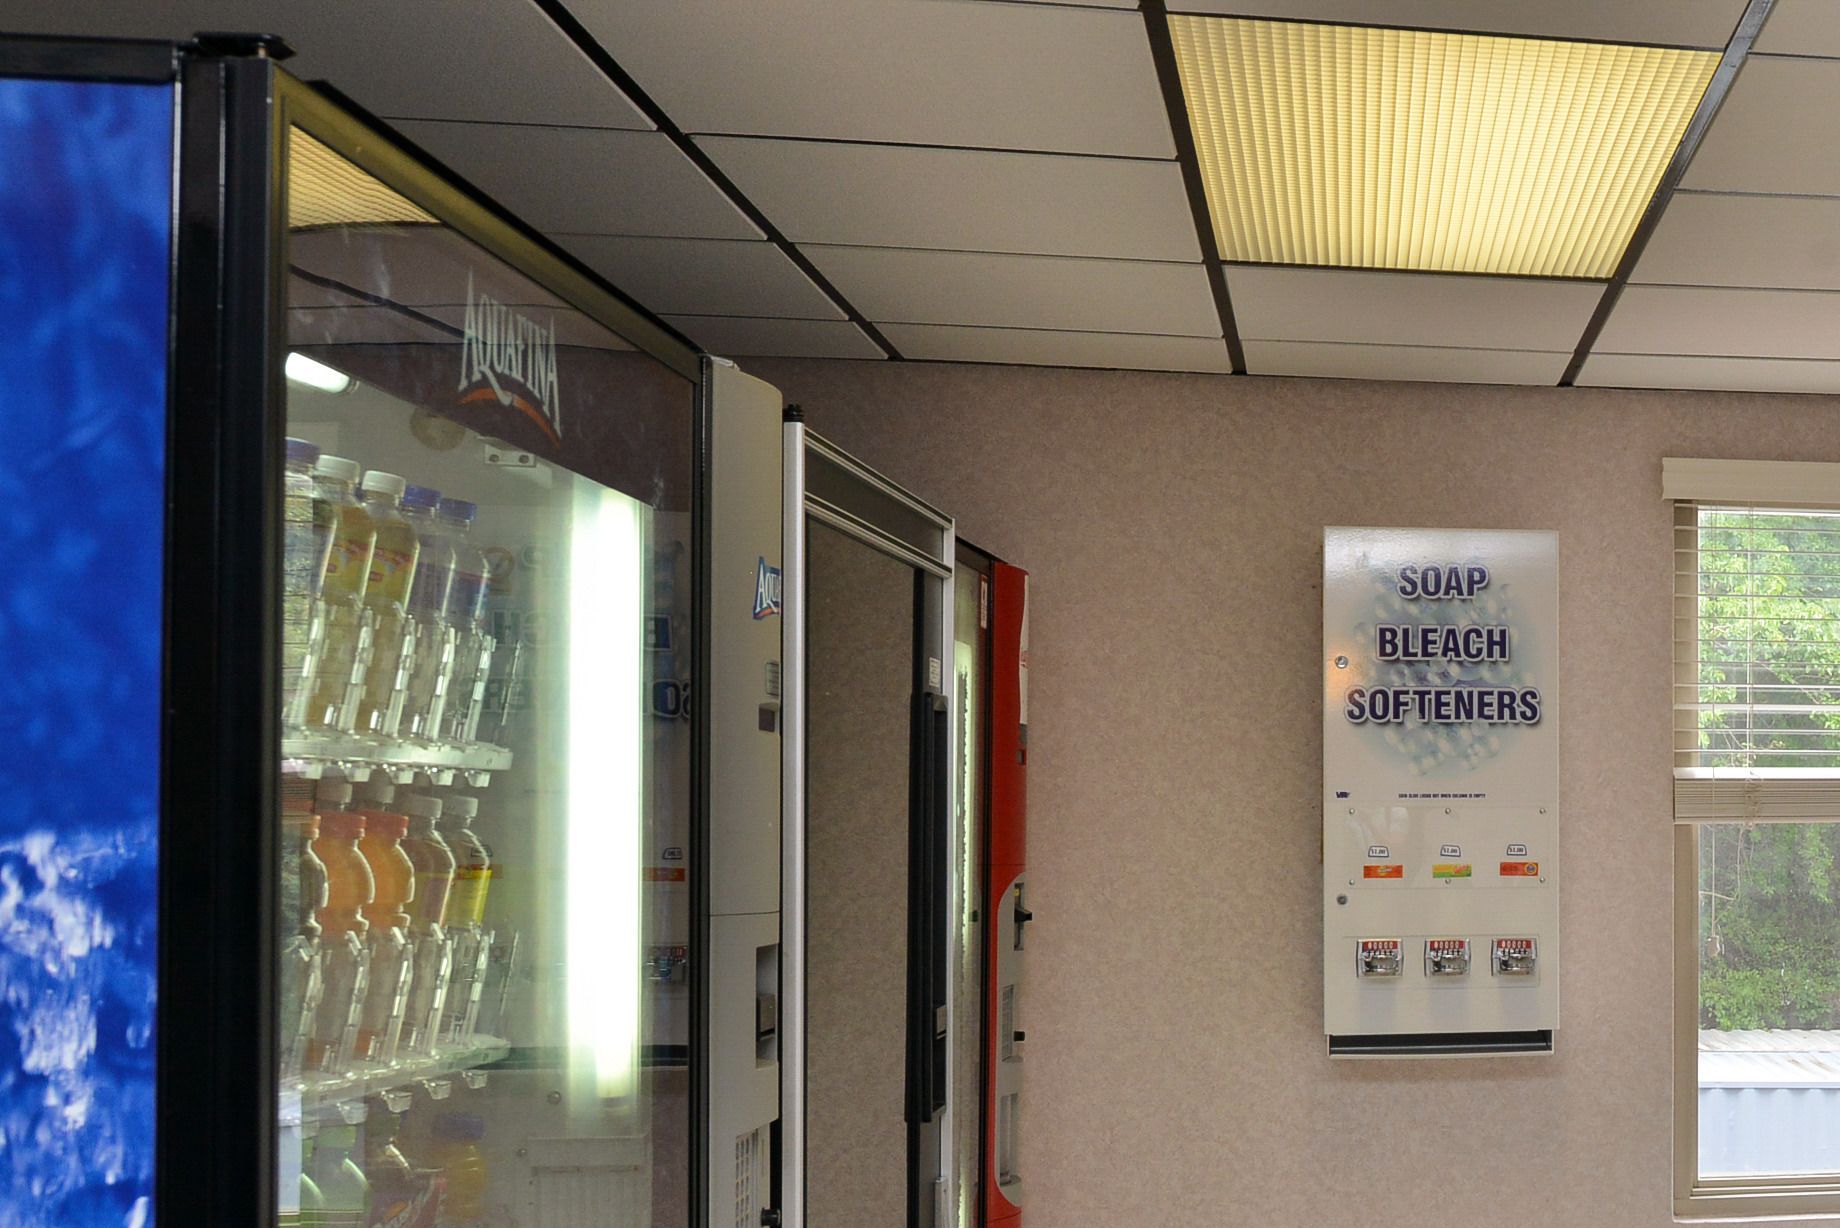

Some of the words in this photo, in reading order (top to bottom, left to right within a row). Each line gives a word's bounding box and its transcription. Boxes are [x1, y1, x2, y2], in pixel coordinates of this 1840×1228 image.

[458, 268, 562, 438] AQUAFINA
[1398, 563, 1488, 598] SOAP
[1377, 625, 1509, 661] BLEACH
[1346, 687, 1540, 722] SOFTENERS
